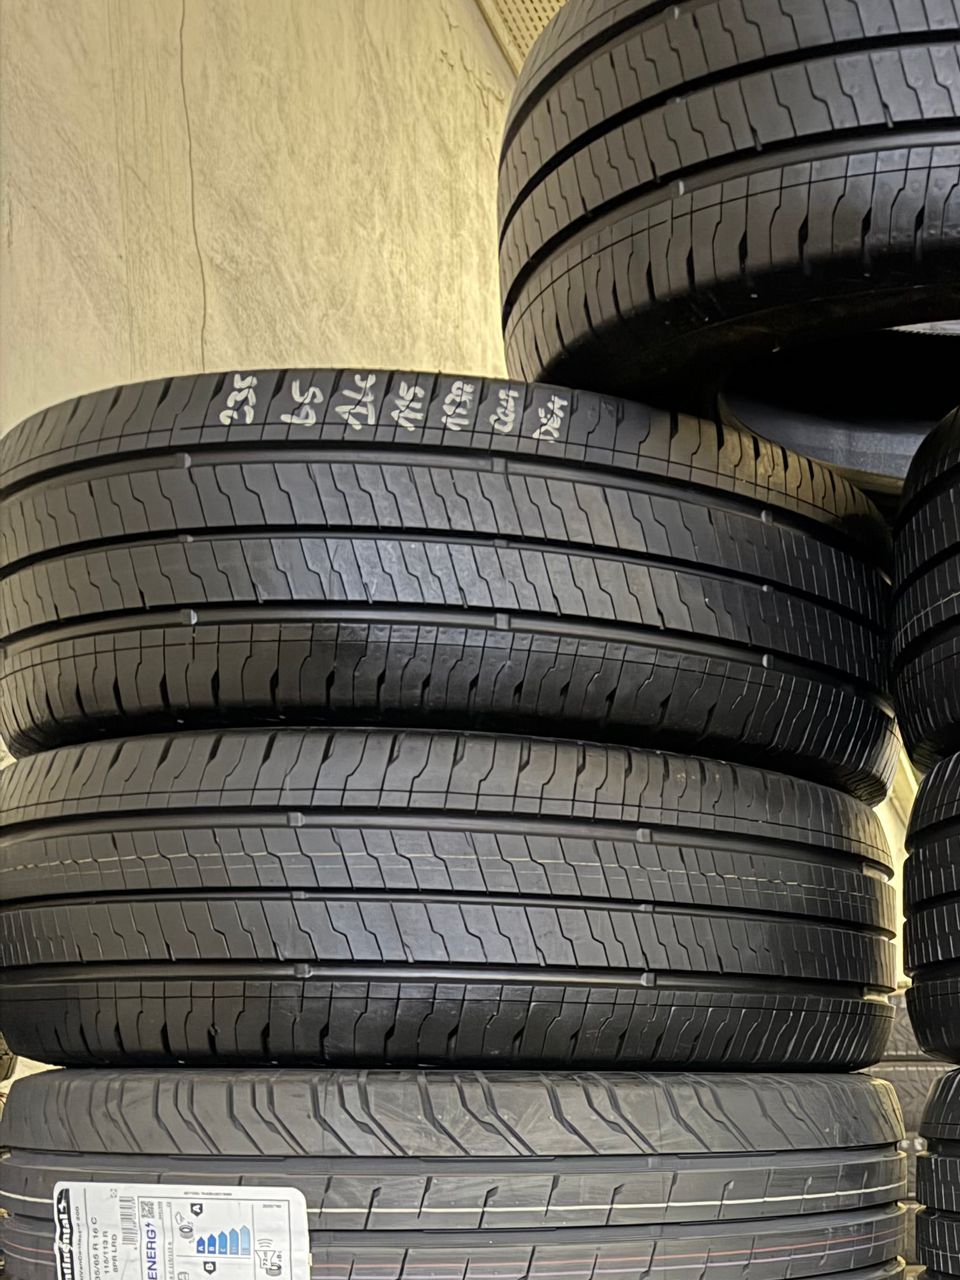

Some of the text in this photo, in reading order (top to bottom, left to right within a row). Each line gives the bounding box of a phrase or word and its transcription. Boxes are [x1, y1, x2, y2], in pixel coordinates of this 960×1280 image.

[220, 373, 257, 425] 235
[280, 379, 324, 426] 65
[391, 380, 425, 431] 115
[91, 1216, 98, 1225] C
[92, 1228, 99, 1242] 16
[92, 1243, 99, 1251] R
